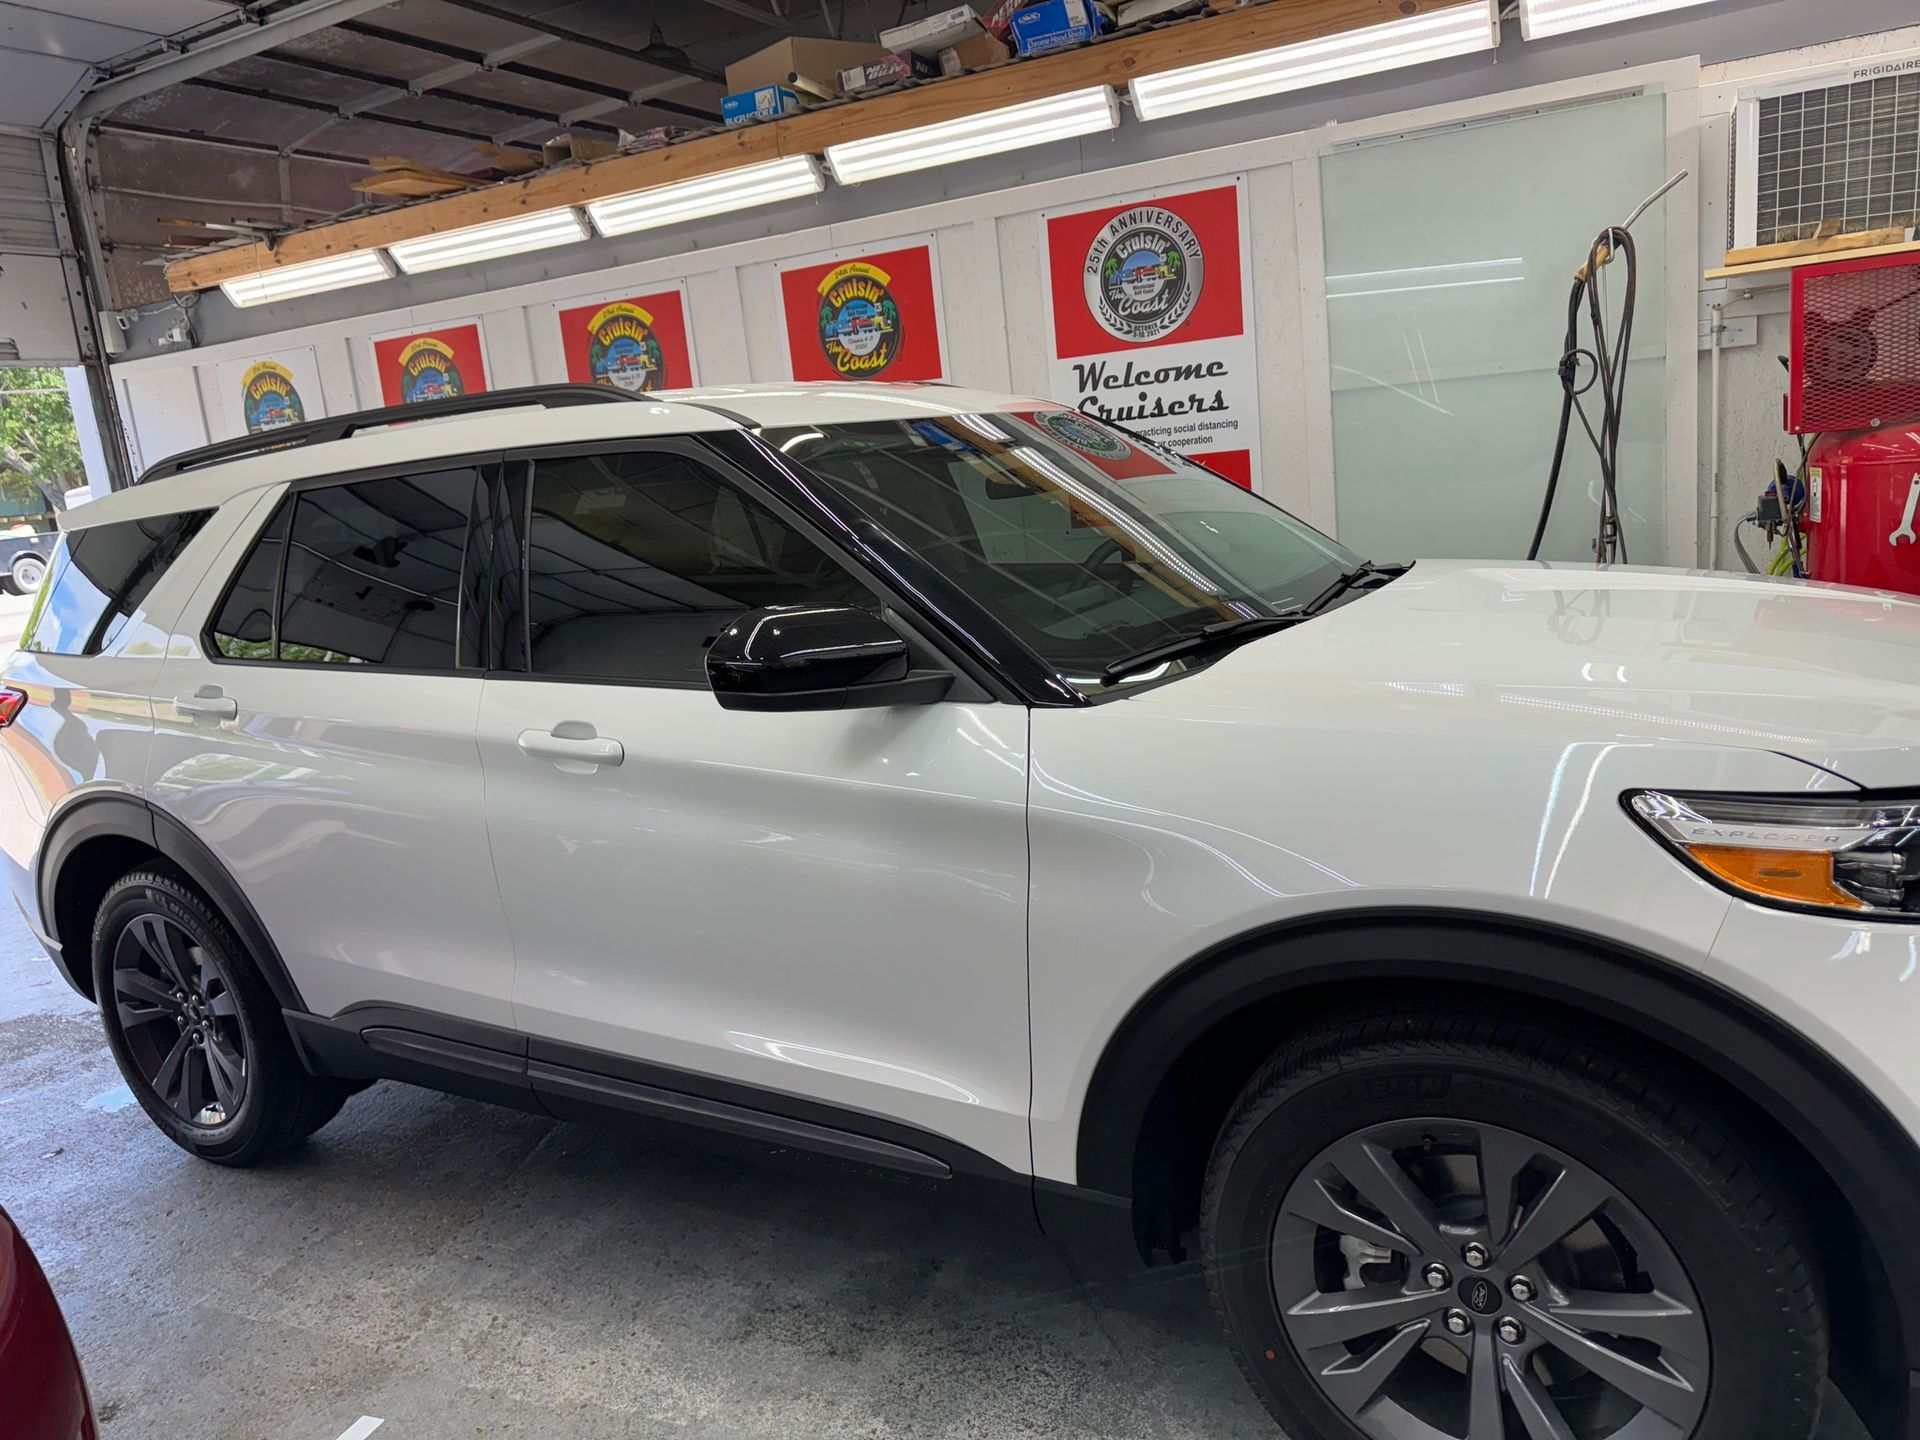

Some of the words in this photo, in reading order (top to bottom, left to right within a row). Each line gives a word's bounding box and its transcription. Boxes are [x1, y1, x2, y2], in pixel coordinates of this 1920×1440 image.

[1853, 59, 1920, 79] FRIGIDAIRE
[1087, 238, 1108, 274] 25th
[1110, 210, 1201, 259] ANNIVERSARY
[1118, 289, 1169, 316] Coast
[836, 343, 888, 372] Coast
[1072, 360, 1228, 393] Welcome
[1076, 389, 1230, 425] Cruisers
[1174, 423, 1196, 433] social
[1198, 418, 1239, 431] distancing
[1168, 435, 1213, 448] cooperation
[1692, 827, 1840, 843] EXPLORER
